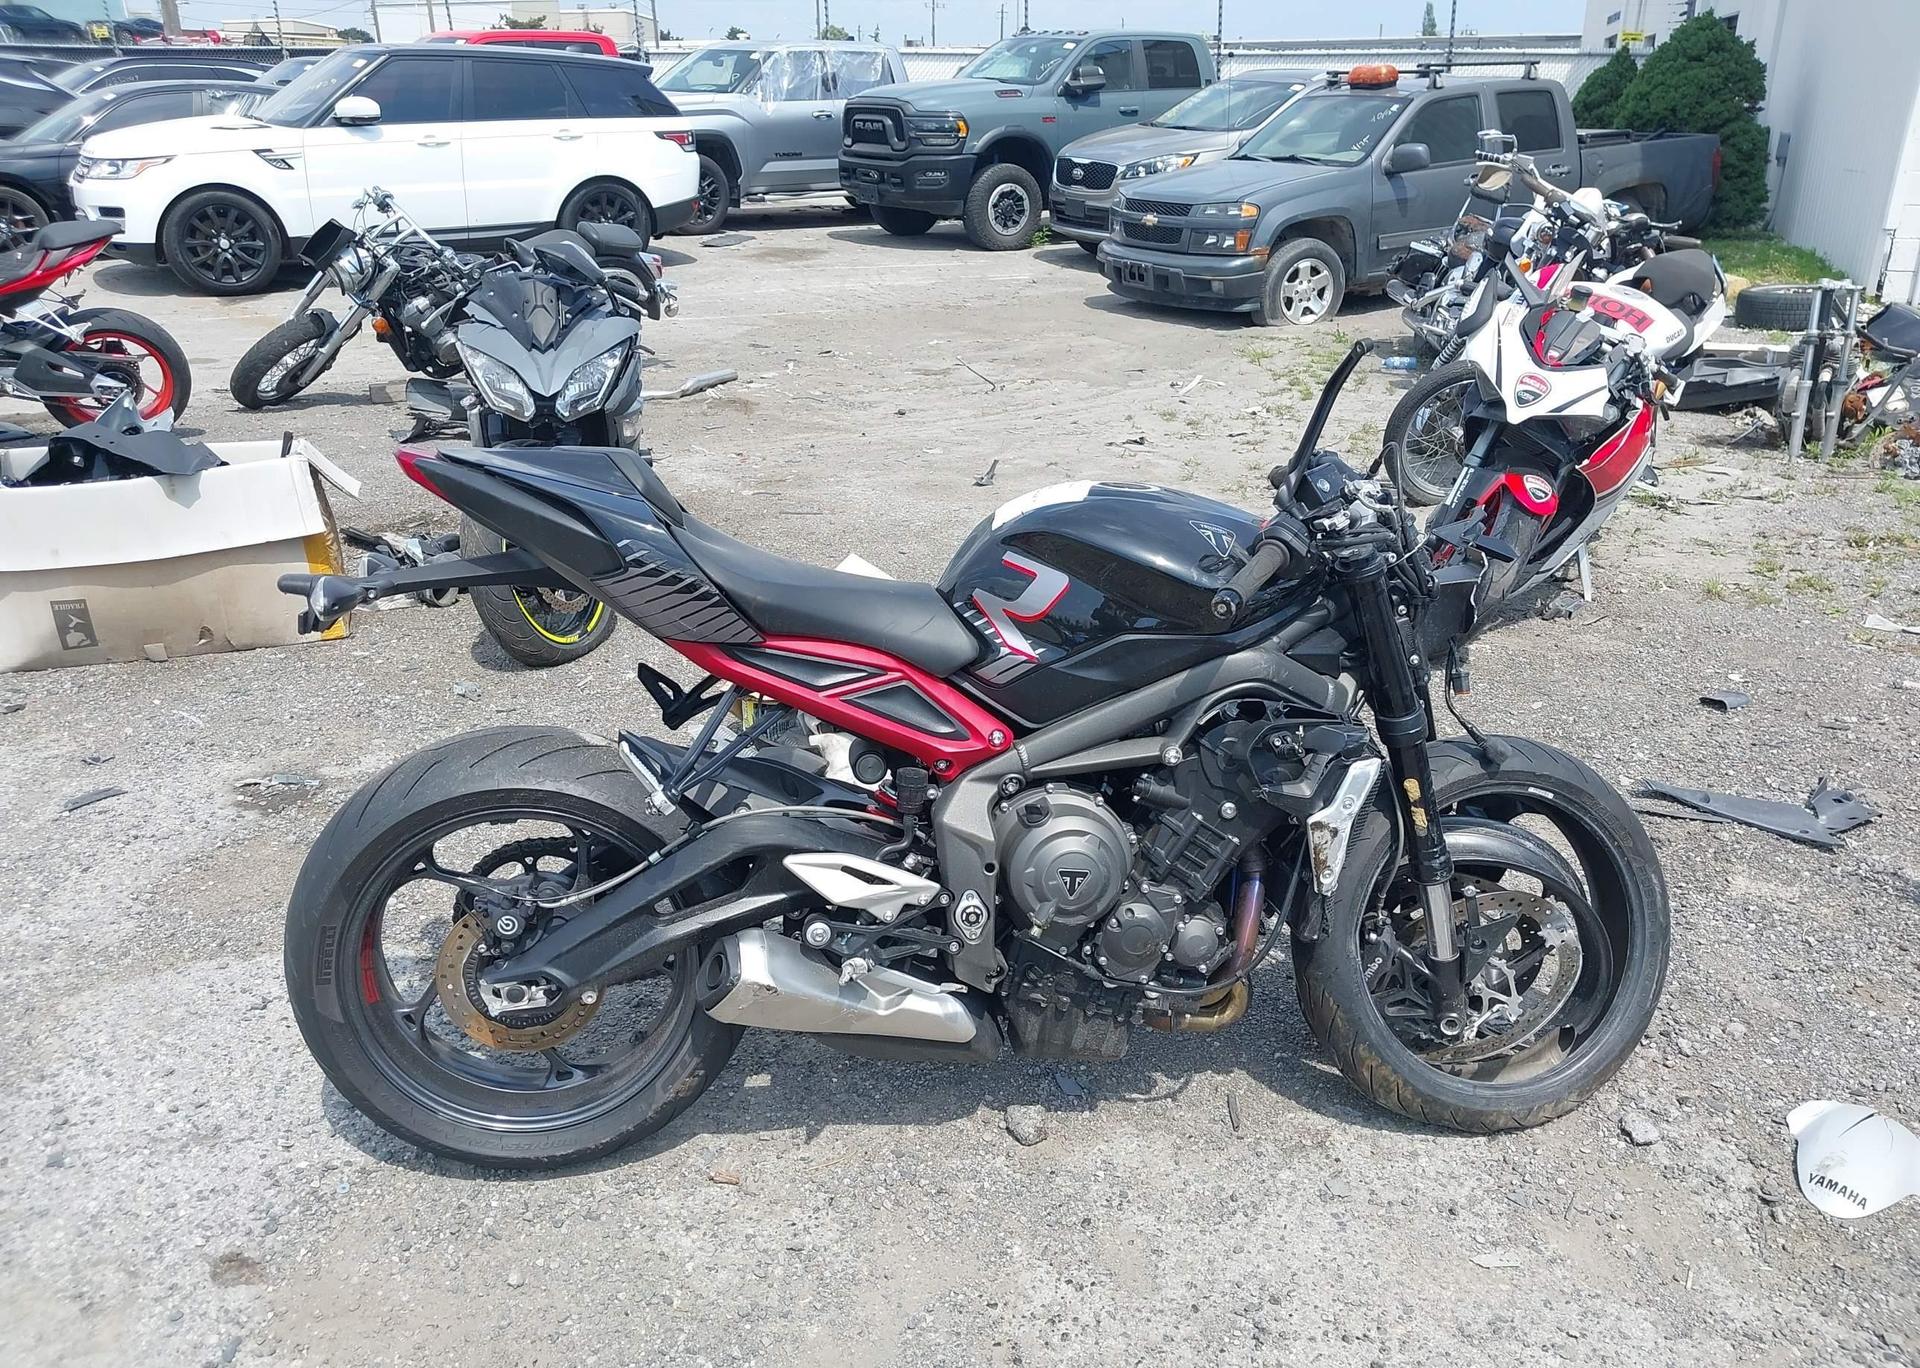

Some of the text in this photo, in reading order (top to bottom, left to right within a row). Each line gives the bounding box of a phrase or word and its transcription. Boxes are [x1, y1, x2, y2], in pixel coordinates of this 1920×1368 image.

[855, 120, 883, 131] RAM
[52, 603, 85, 611] FRAGILE
[1807, 1172, 1868, 1210] YAMAHA
